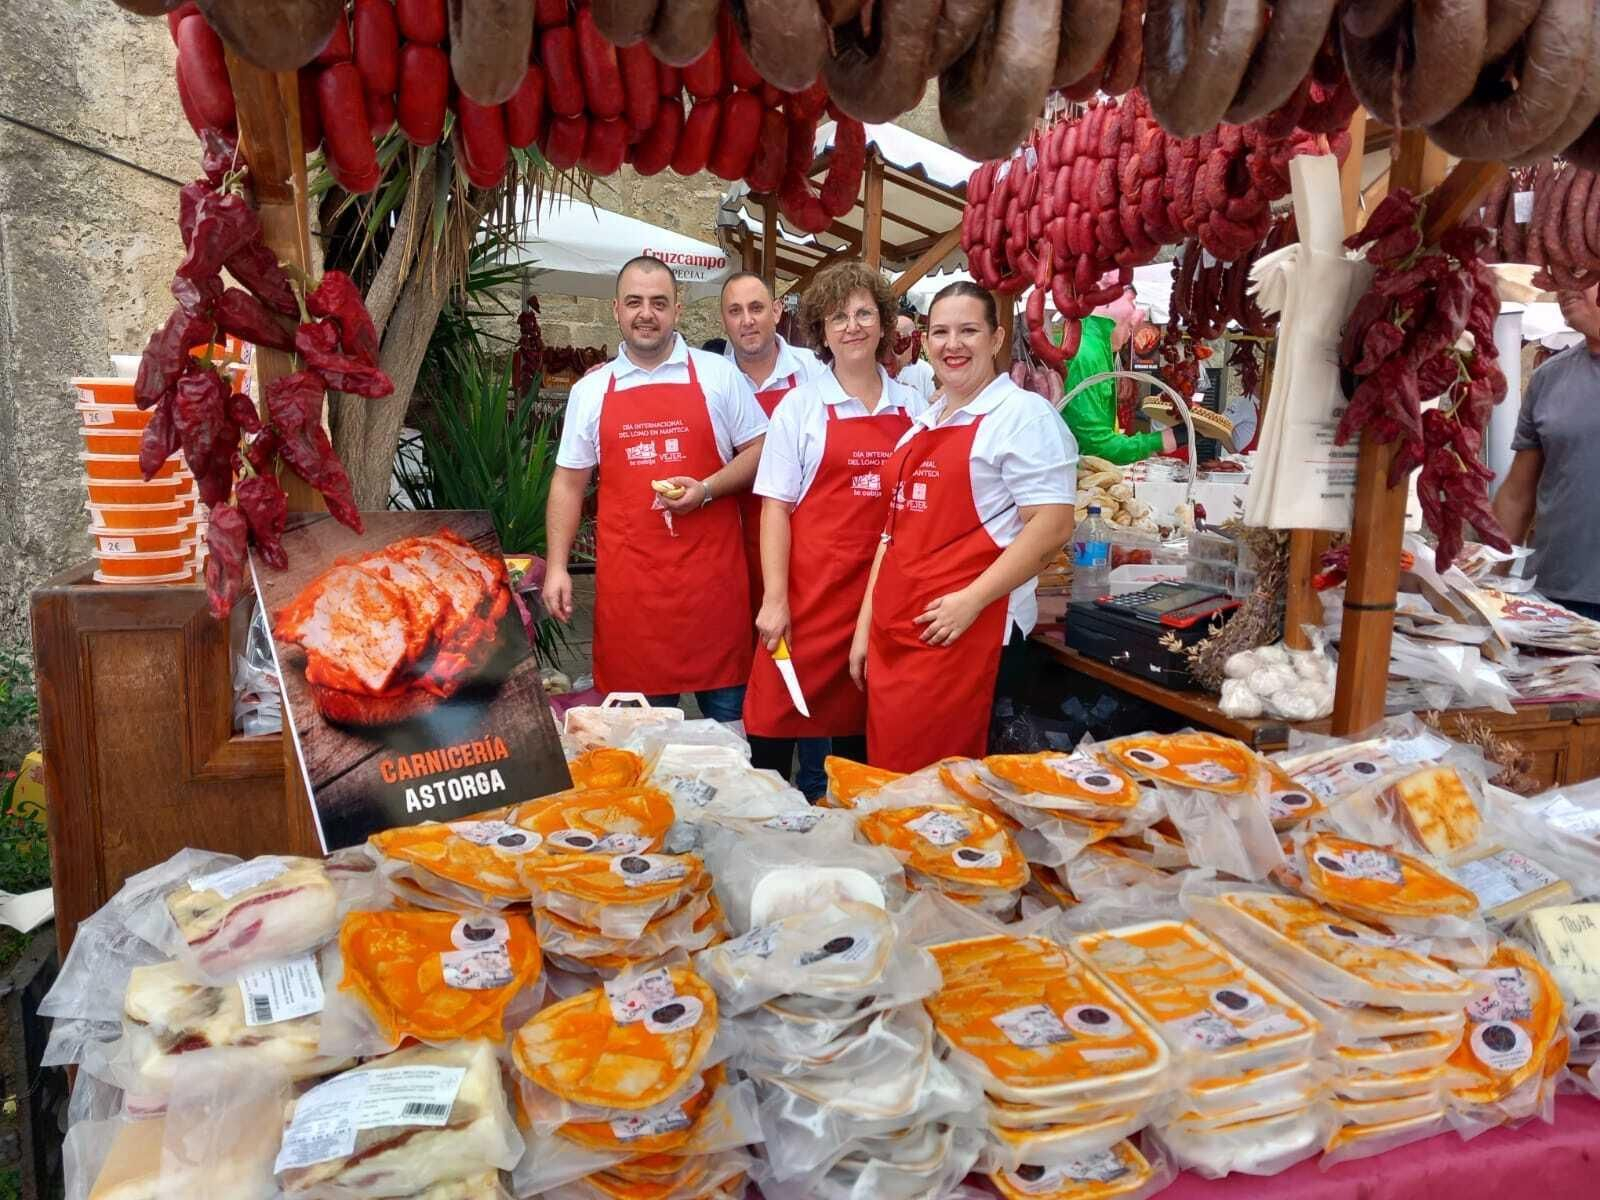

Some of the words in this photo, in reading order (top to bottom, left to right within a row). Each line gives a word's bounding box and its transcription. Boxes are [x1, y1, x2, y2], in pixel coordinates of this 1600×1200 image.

[642, 248, 726, 270] Cruzcampo
[634, 419, 684, 430] INTERNACIONAL
[631, 430, 649, 438] LOMO
[660, 426, 689, 435] MANTECA
[853, 450, 864, 458] DÍA
[848, 458, 859, 466] DEL
[107, 541, 121, 552] 2€
[380, 734, 510, 784] CARNICERÍA
[405, 768, 506, 813] ASTORGA
